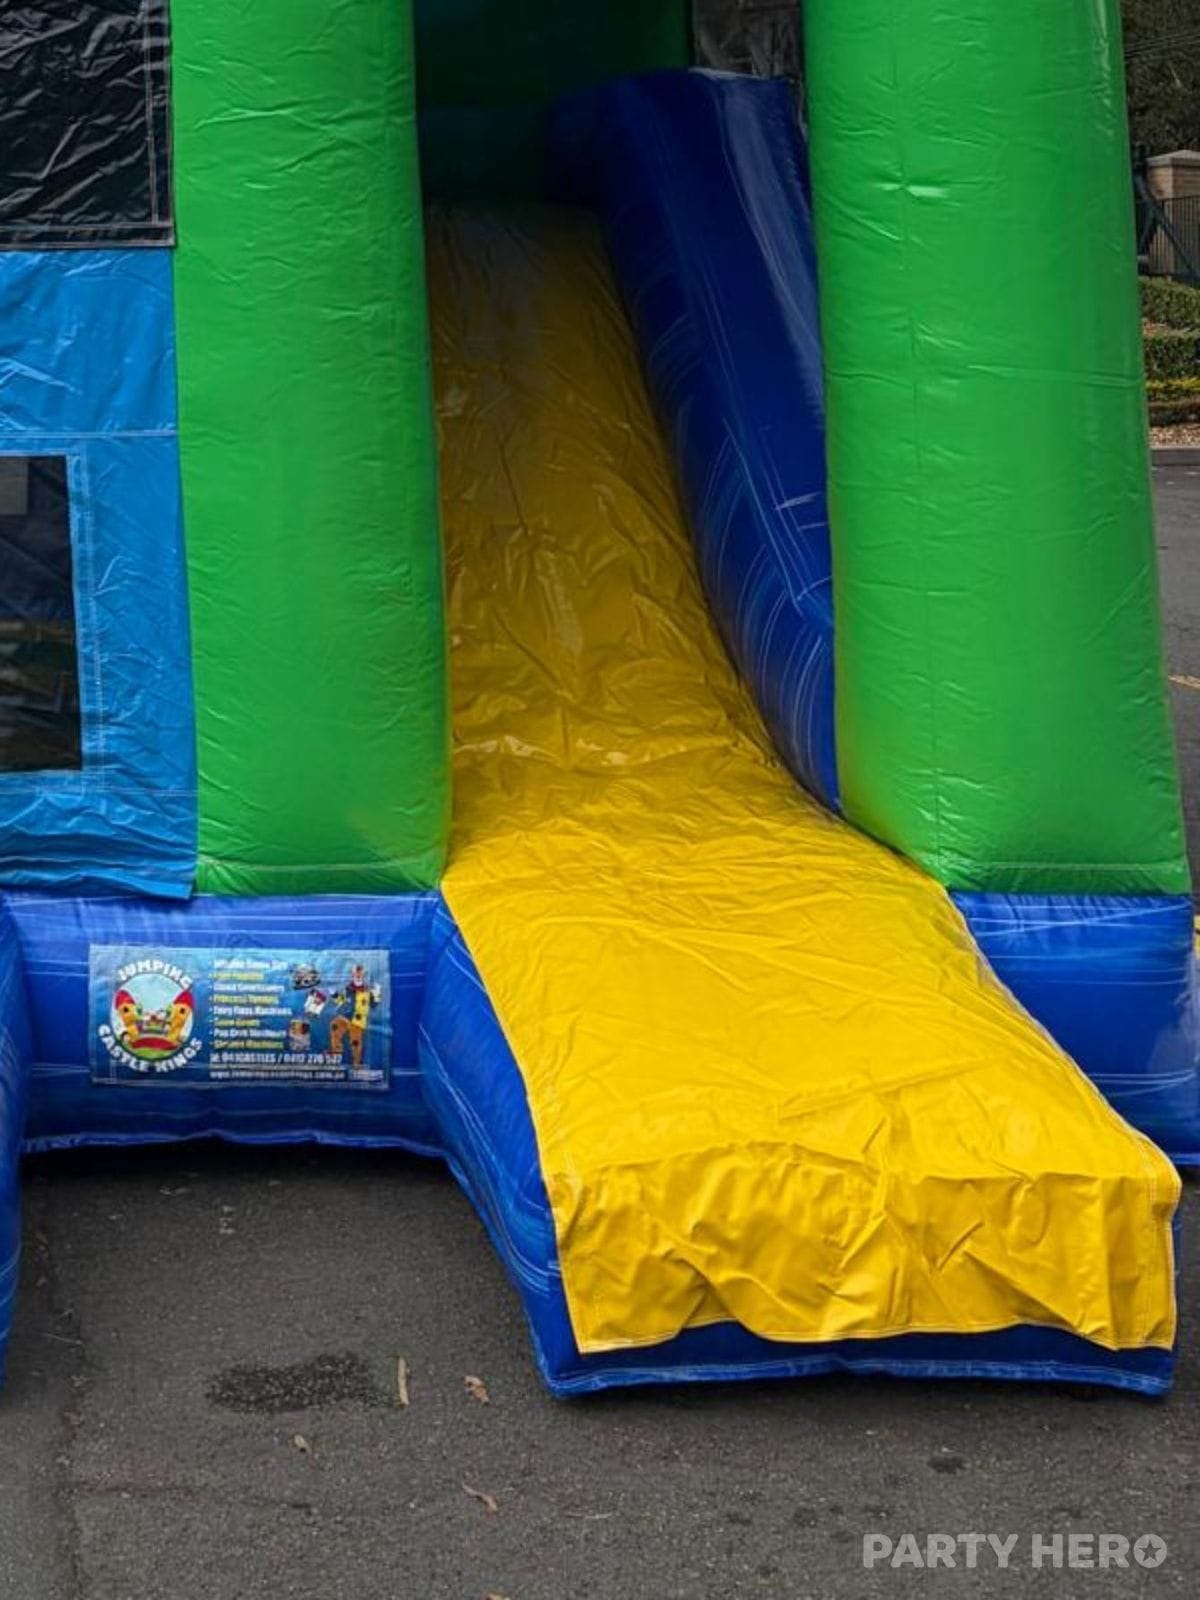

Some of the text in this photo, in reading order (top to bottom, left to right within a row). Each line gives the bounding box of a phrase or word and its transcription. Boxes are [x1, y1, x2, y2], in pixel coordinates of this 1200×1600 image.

[118, 959, 193, 989] JUMPING
[98, 1024, 203, 1073] CASTLE KINGS
